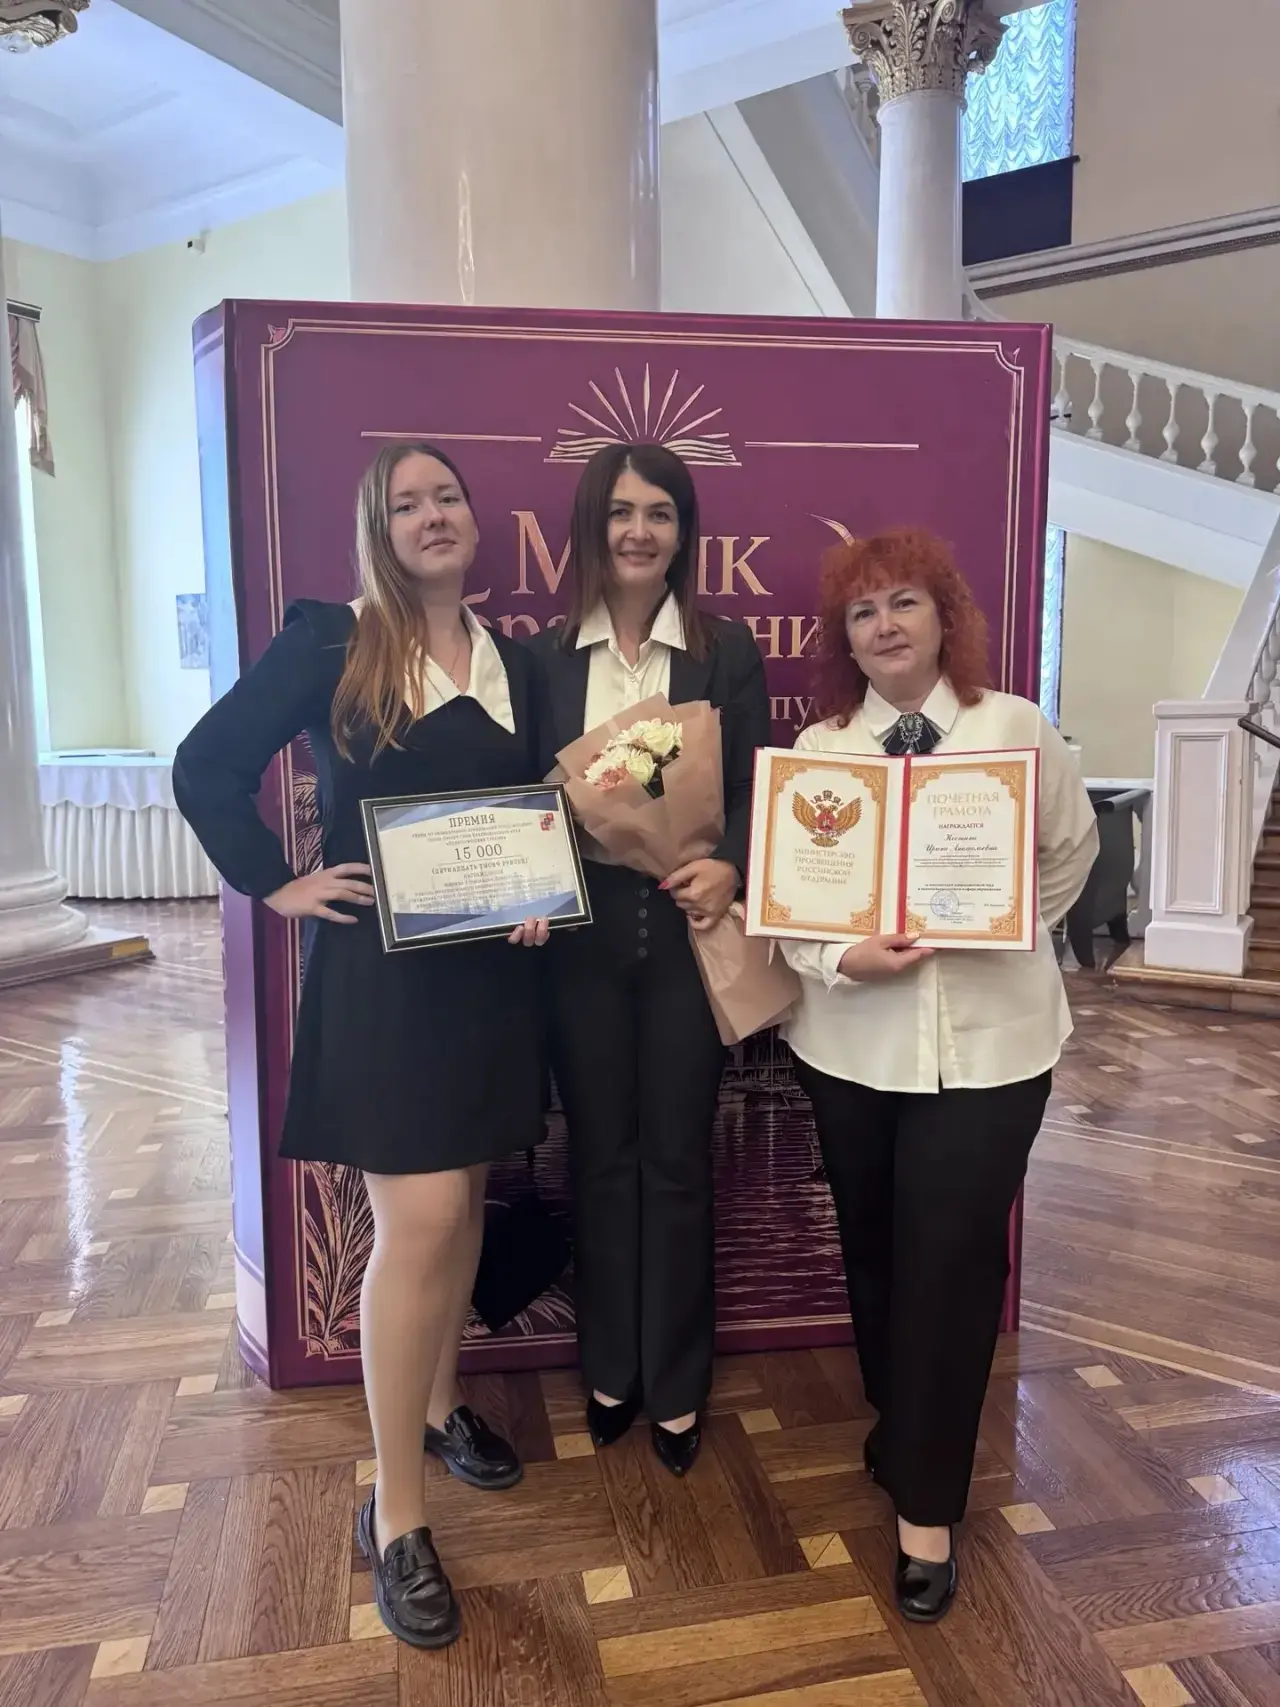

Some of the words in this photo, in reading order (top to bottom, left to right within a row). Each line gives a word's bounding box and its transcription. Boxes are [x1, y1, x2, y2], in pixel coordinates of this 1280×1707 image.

[927, 791, 1000, 805] ПОЧЕТНАЯ
[933, 805, 992, 819] ГРАМОТА
[448, 813, 497, 828] ПРЕМИЯ
[938, 822, 984, 830] НАГРАЖДАЕТСЯ
[454, 846, 472, 861] 15
[476, 843, 503, 858] 000
